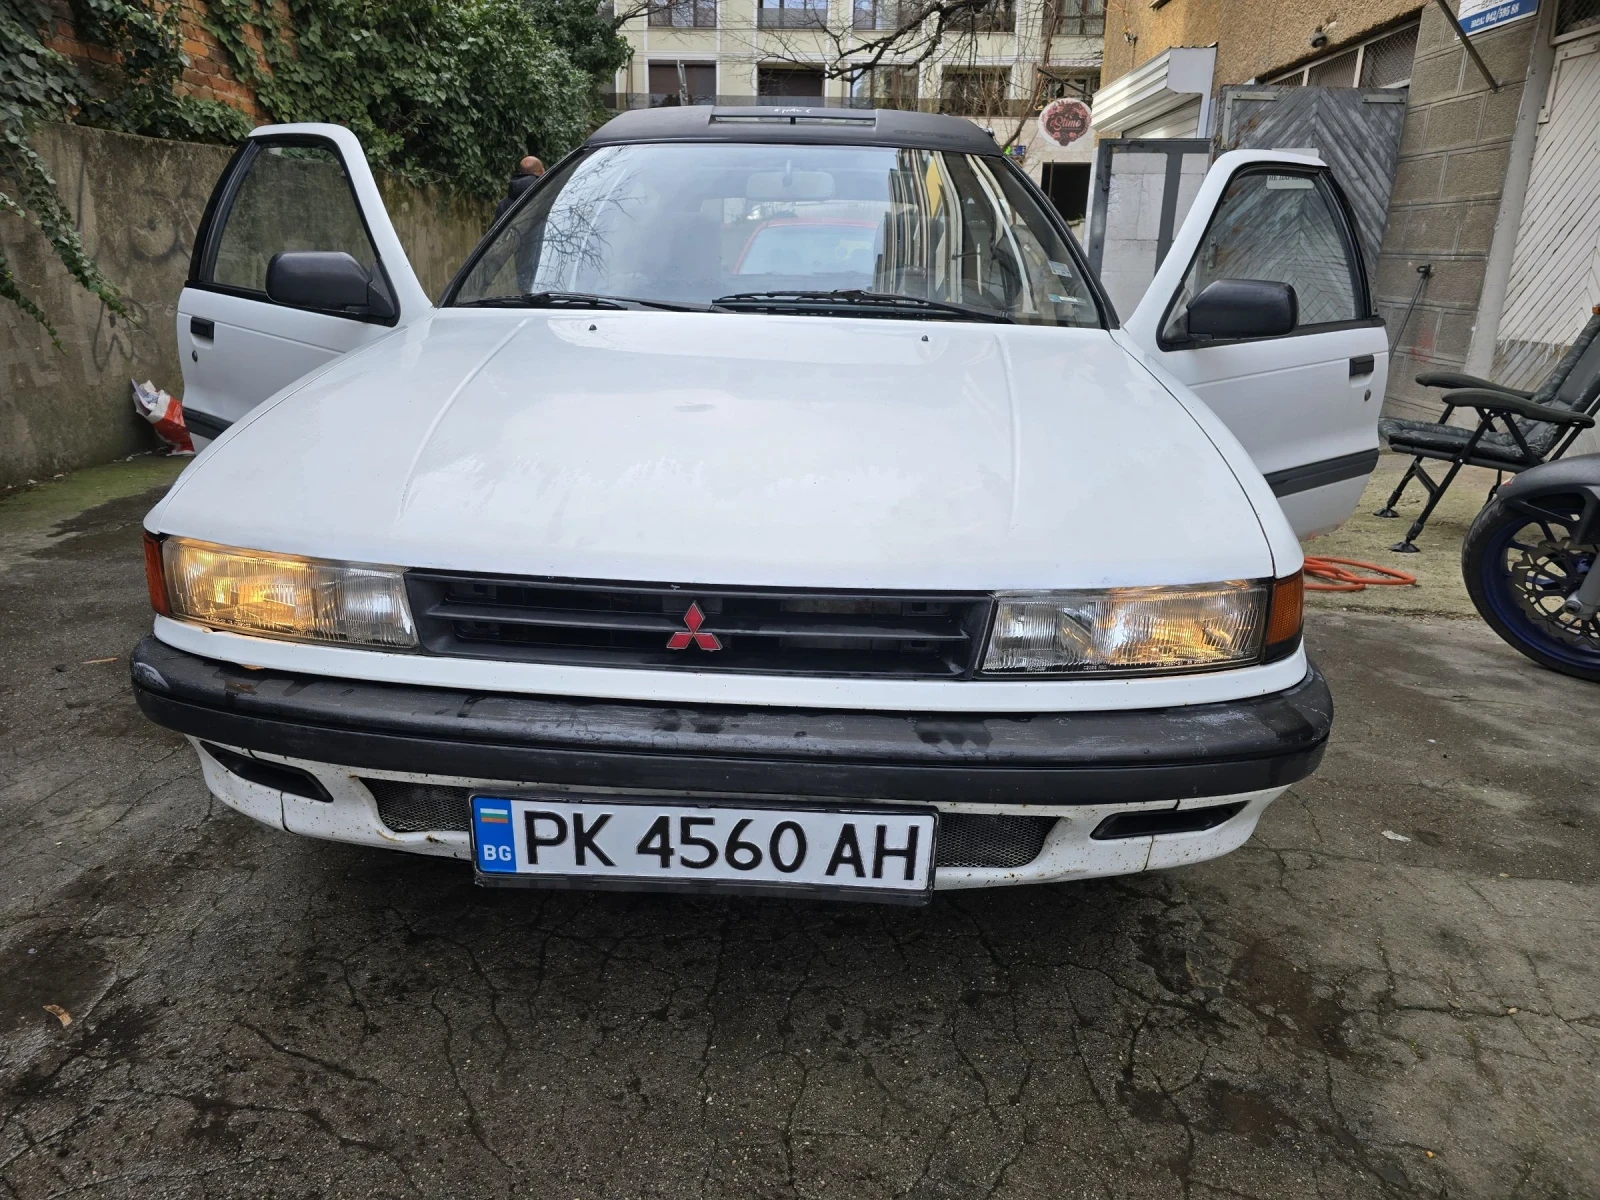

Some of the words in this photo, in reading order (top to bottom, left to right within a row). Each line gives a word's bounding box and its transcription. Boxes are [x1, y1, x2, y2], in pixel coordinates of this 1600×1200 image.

[483, 844, 512, 861] BG
[523, 810, 618, 867] PK
[635, 815, 808, 874] 4560
[824, 823, 920, 881] AH
